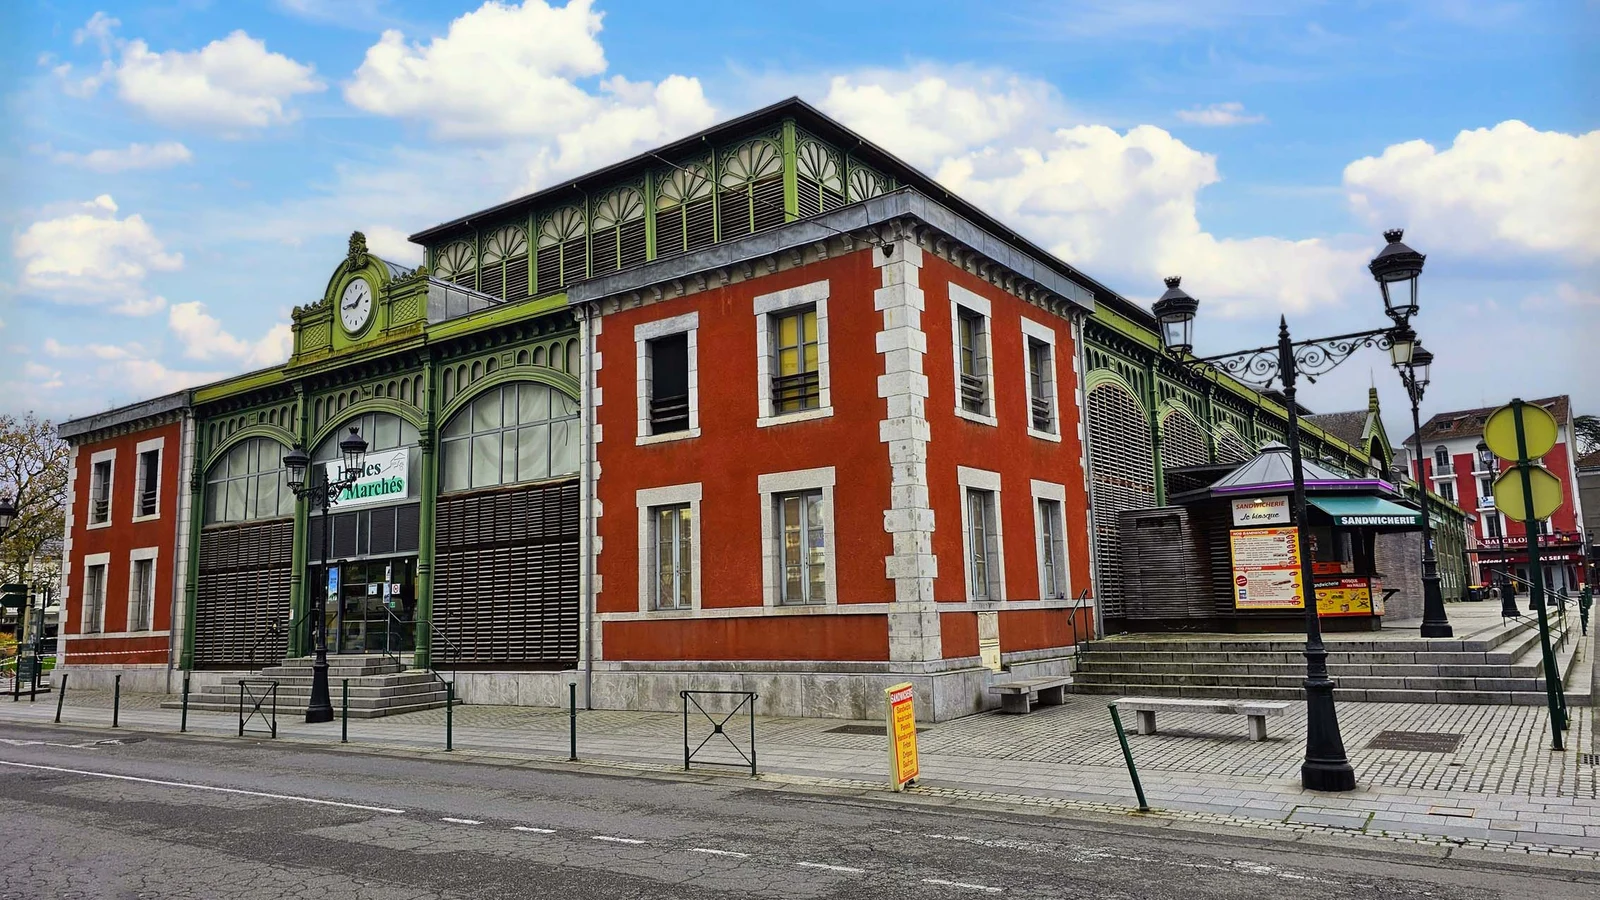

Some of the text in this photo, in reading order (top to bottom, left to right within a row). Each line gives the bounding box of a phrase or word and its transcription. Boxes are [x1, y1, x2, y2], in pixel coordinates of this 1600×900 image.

[337, 462, 382, 481] Hles
[346, 476, 403, 500] Marchés
[1236, 501, 1285, 510] SANDWICHERIE
[1252, 513, 1280, 521] kiosque
[1341, 516, 1416, 525] SANDWICHERIE
